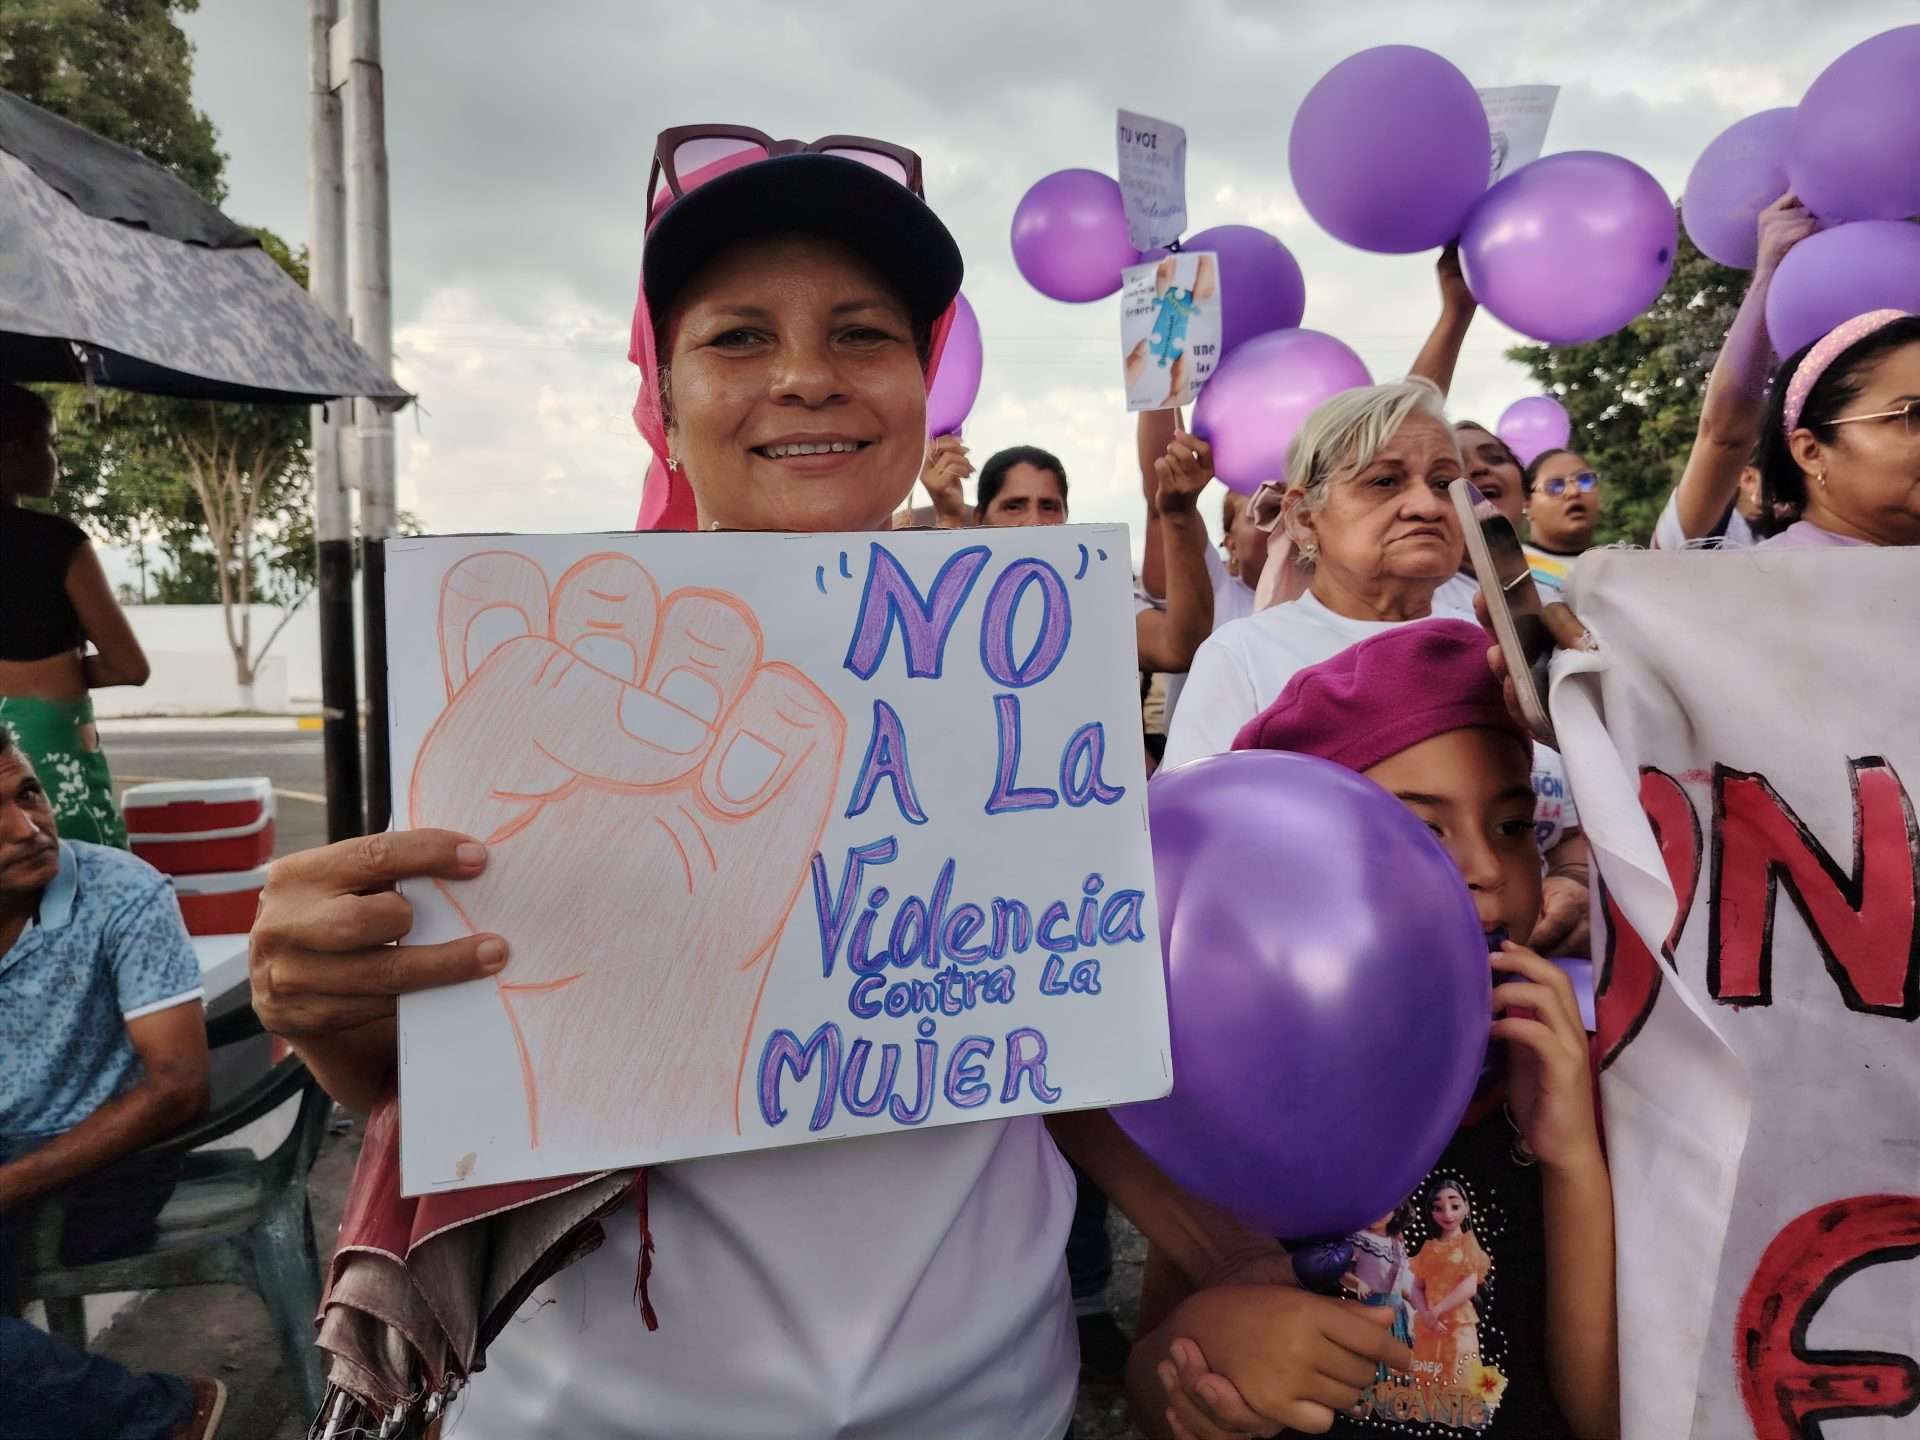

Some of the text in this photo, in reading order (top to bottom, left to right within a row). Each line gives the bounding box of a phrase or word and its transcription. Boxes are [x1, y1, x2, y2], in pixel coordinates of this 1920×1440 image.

[1119, 126, 1158, 150] TU VOZ
[1192, 344, 1216, 357] une
[843, 693, 1126, 825] A La
[810, 834, 1146, 978] Violencia
